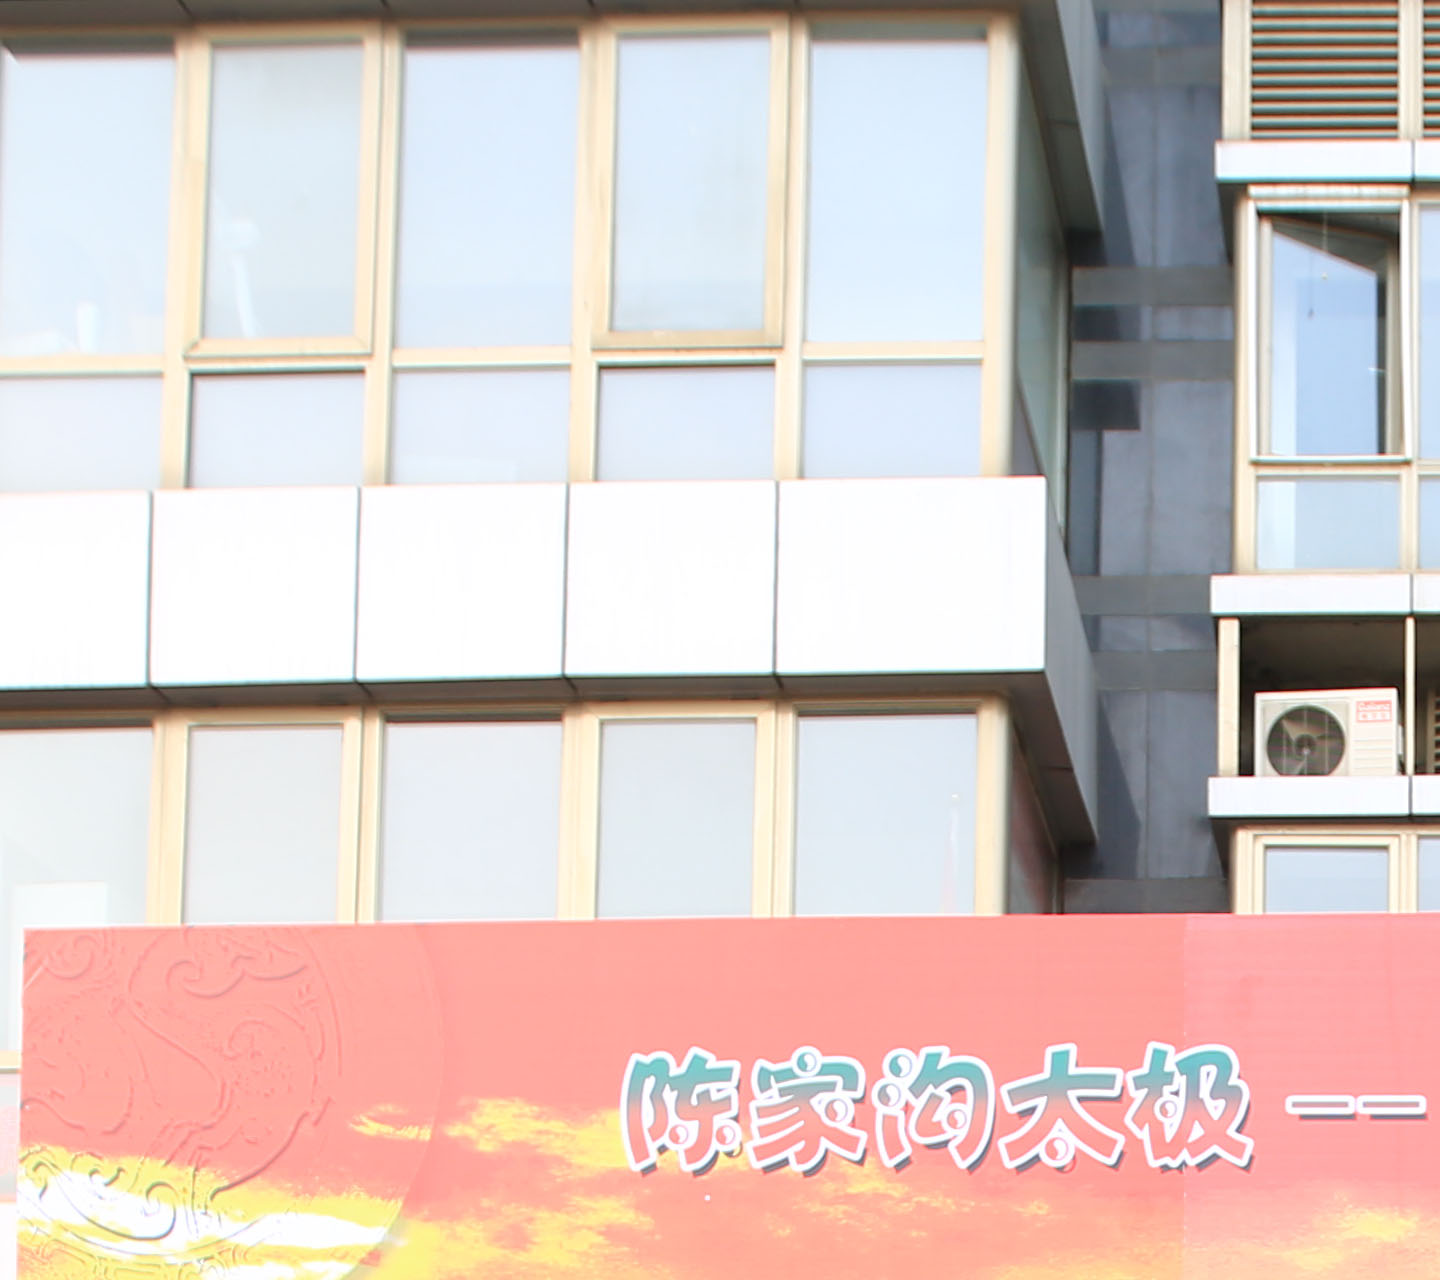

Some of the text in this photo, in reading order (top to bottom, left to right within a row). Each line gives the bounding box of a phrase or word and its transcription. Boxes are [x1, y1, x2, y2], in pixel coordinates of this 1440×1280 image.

[622, 1040, 1257, 1172] 陈家沟太极
